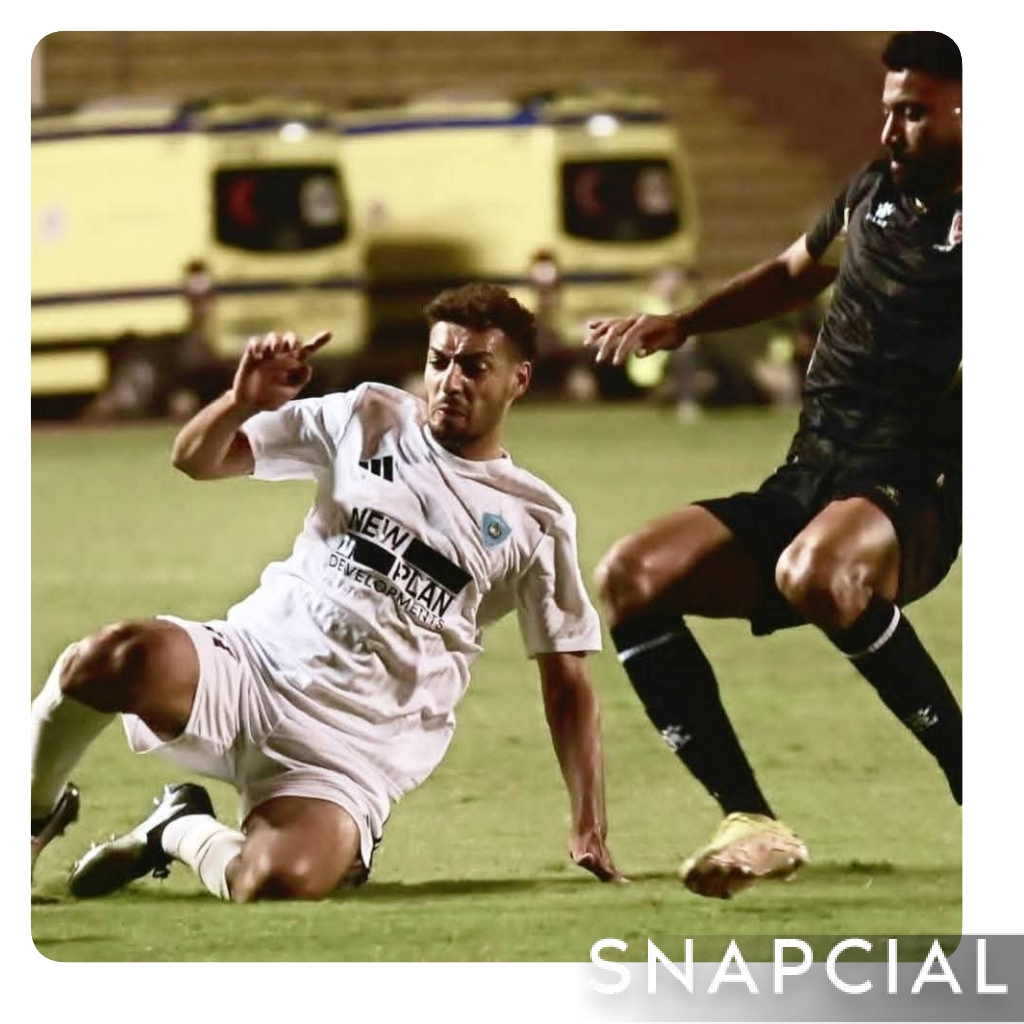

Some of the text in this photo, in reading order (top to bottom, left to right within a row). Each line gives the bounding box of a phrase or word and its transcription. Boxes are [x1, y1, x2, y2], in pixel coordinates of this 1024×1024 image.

[347, 507, 410, 551] NEW
[329, 554, 445, 631] DEVELOPMENTS
[392, 561, 456, 618] PLAN
